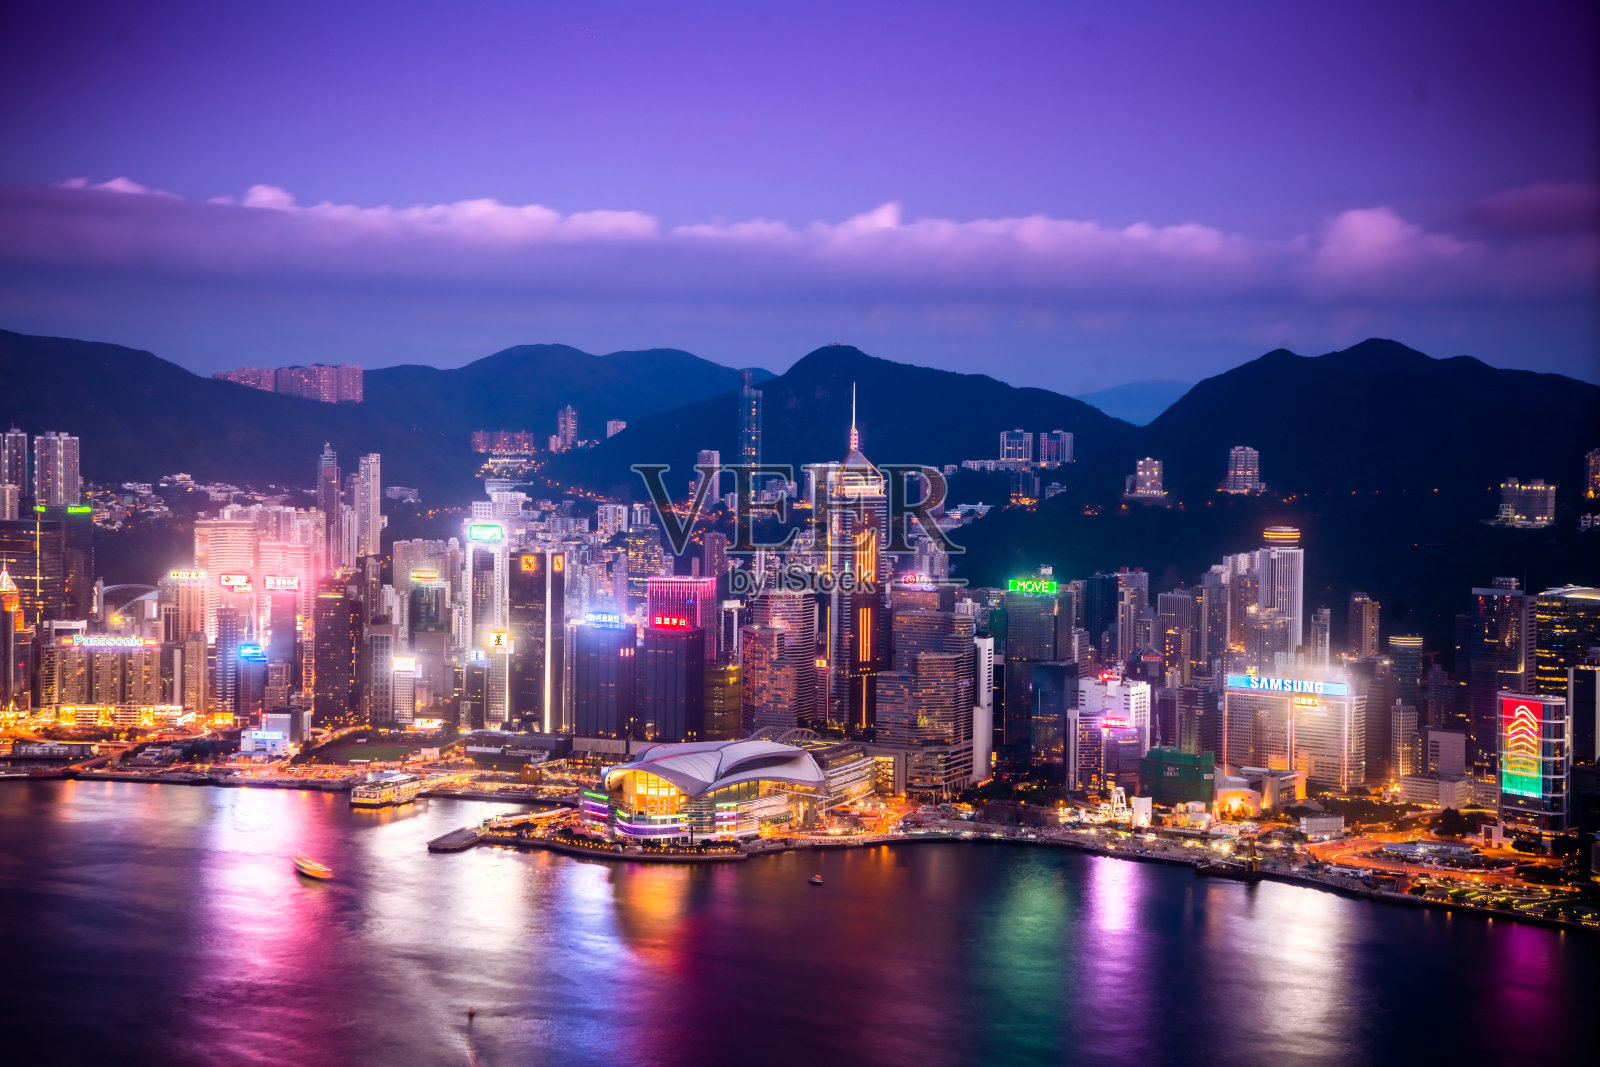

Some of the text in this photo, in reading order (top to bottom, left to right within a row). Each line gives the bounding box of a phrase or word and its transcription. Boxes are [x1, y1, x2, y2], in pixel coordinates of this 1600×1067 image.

[1016, 581, 1049, 593] MOVE
[73, 634, 144, 647] Panasonic
[1250, 676, 1324, 694] SAMSUNG
